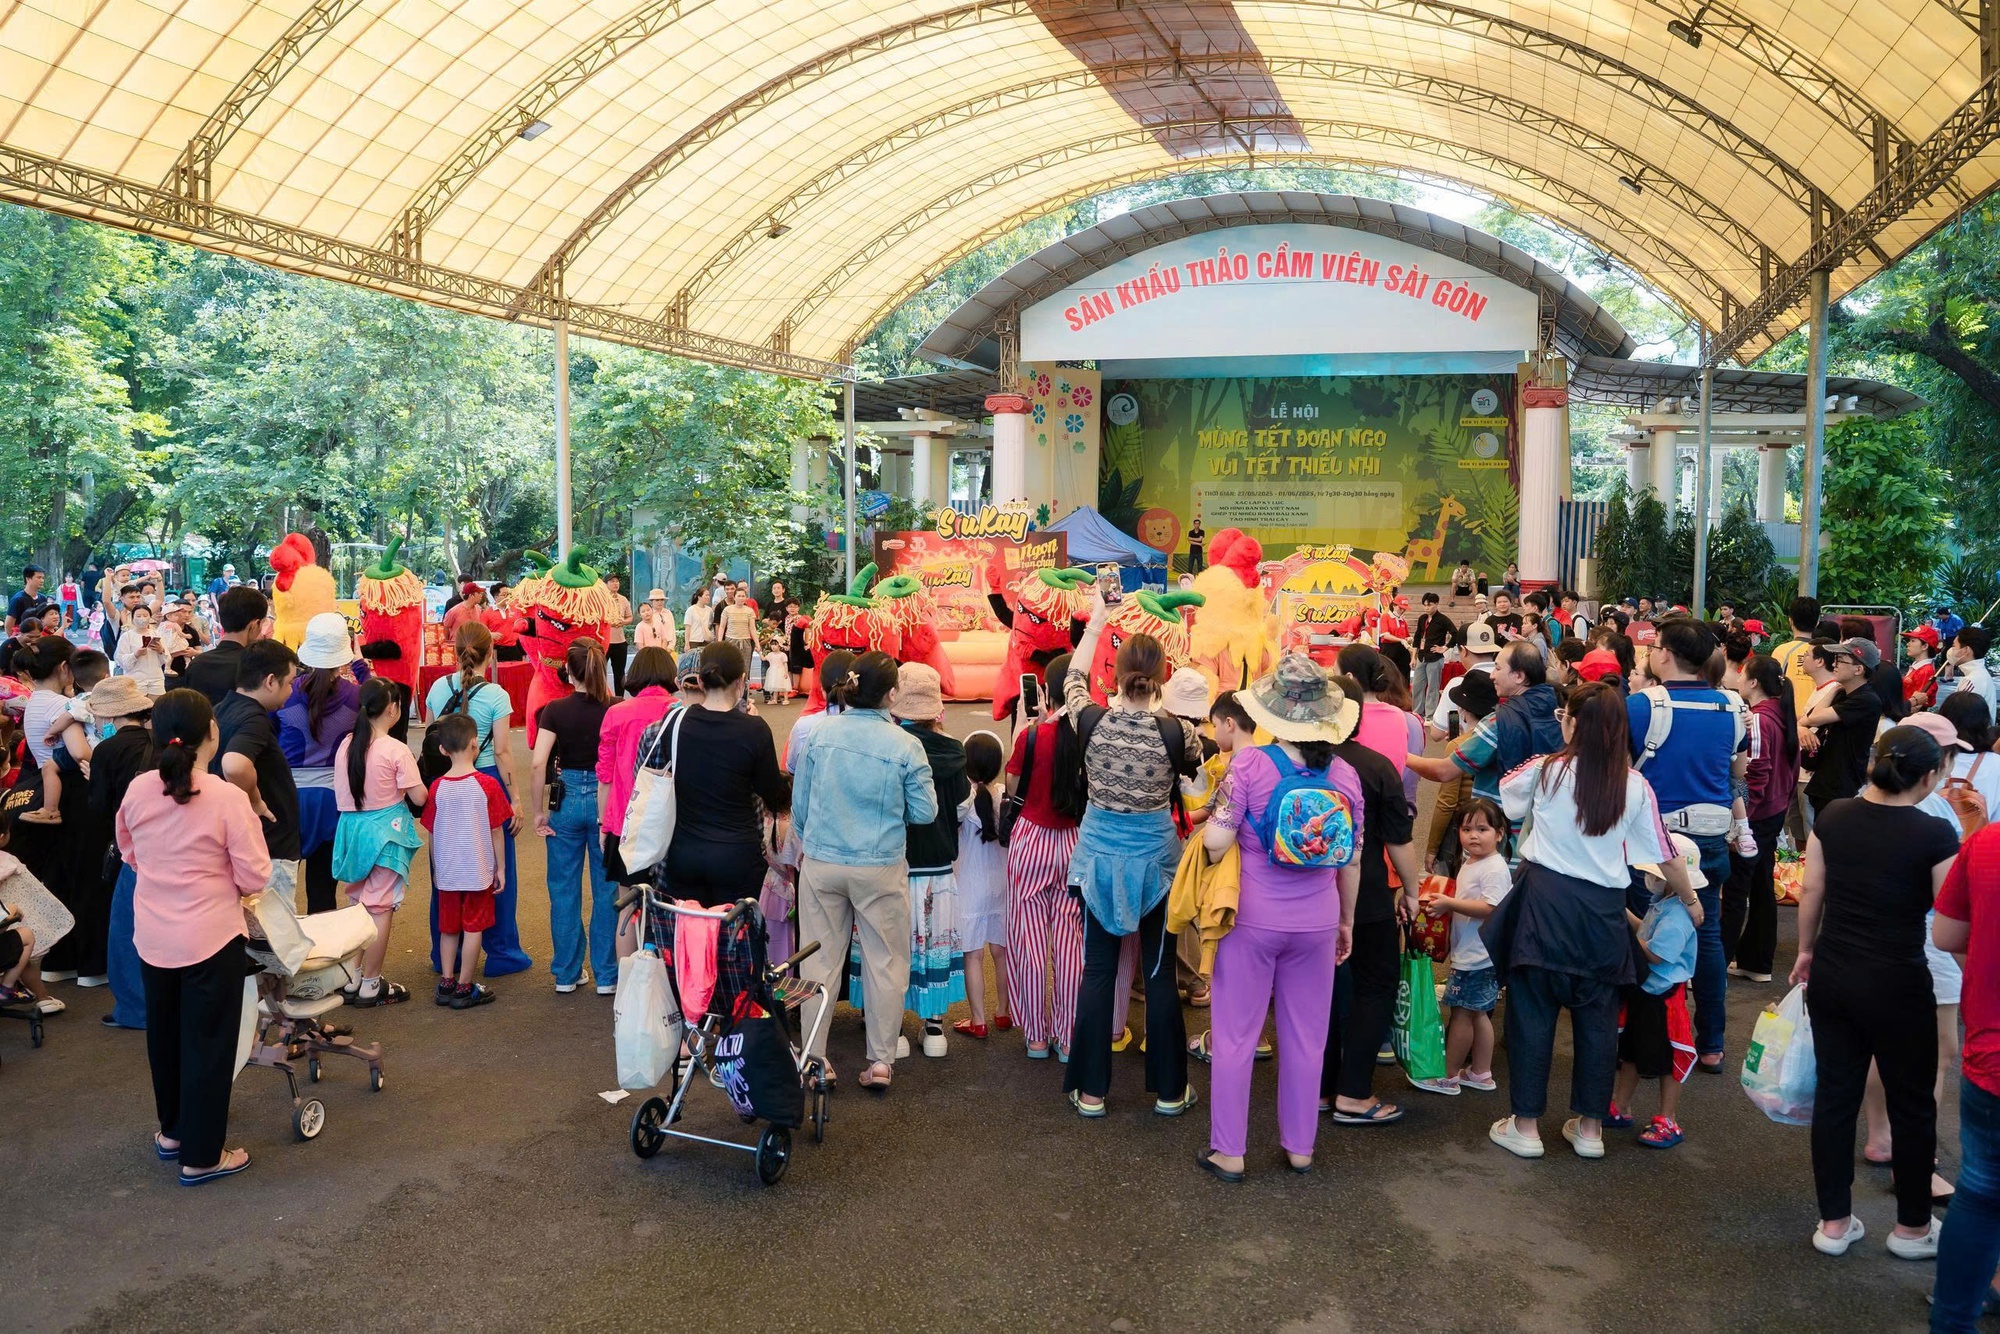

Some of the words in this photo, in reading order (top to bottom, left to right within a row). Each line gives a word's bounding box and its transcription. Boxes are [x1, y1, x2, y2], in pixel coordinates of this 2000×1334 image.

[1063, 290, 1116, 333] SÂN
[1116, 261, 1181, 310] KHẤU
[1185, 247, 1248, 287] THẢO
[1257, 241, 1314, 279] CẦM
[1321, 251, 1381, 288] VIÊN
[1384, 264, 1429, 300] SÀI
[1431, 279, 1489, 323] GÒN
[1270, 402, 1288, 419] LỄ
[1292, 404, 1319, 421] HỘI
[1198, 425, 1249, 449] MÙNG
[1253, 422, 1292, 448] TẾT
[1296, 428, 1345, 449] ĐOAN
[1348, 428, 1388, 452] NGỌ
[1208, 456, 1239, 476] VUI
[1244, 450, 1282, 476] TẾT
[1285, 449, 1344, 476] THIẾU
[1348, 456, 1382, 476] NHI
